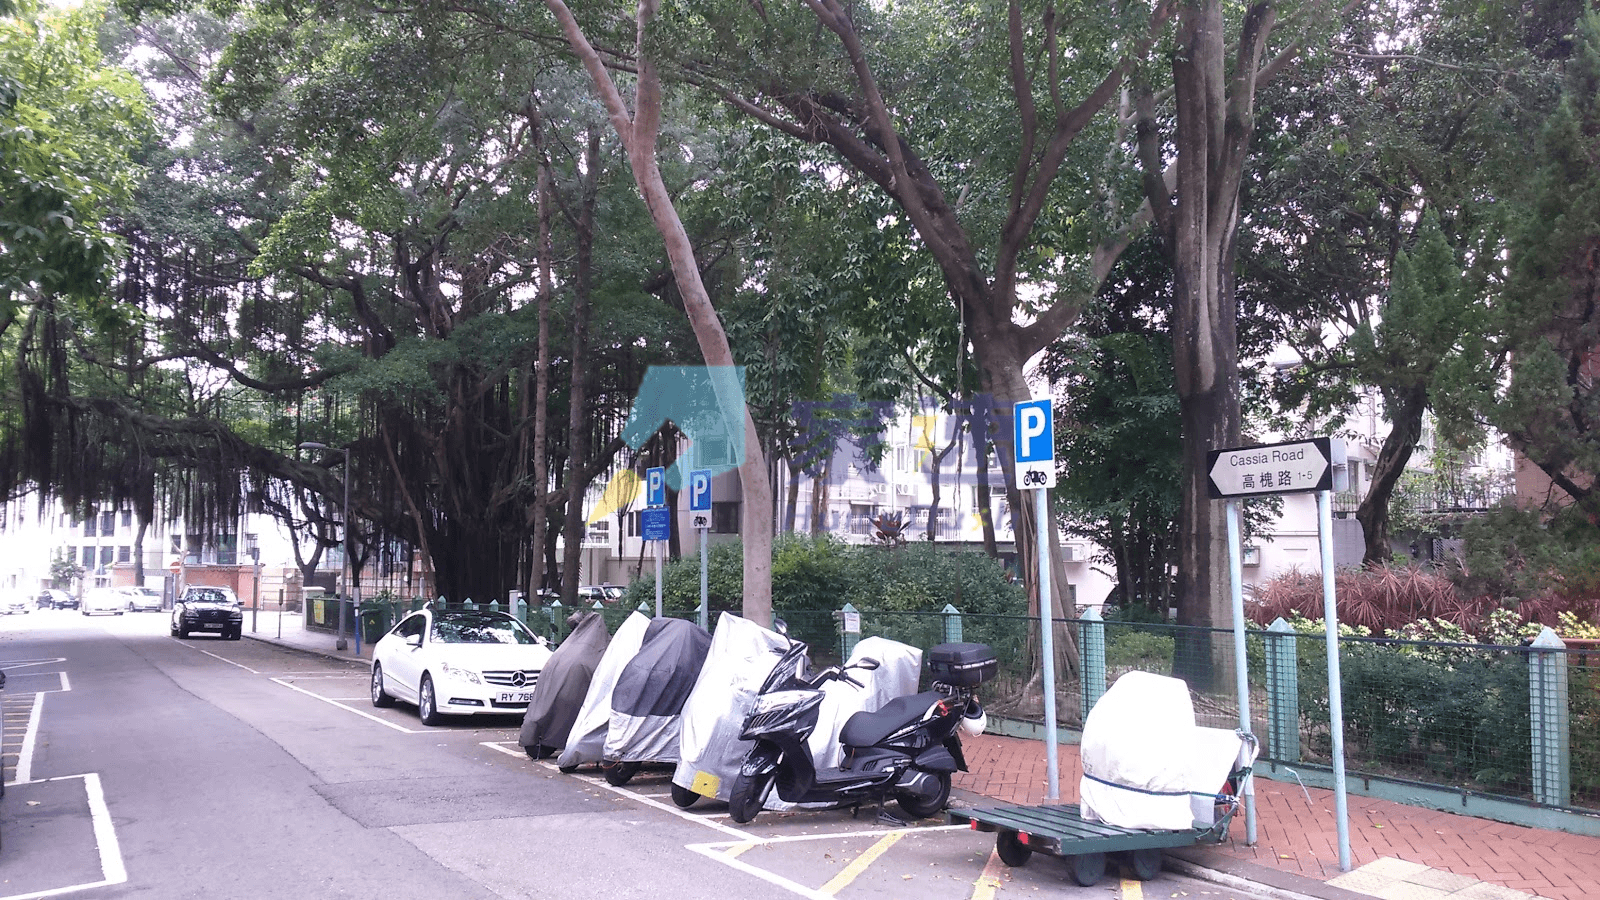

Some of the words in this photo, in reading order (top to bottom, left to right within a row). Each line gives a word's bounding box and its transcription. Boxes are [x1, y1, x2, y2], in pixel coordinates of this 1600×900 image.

[1021, 406, 1046, 457] P
[1230, 453, 1268, 467] Cassia
[1272, 448, 1304, 462] Road
[650, 471, 661, 502] P
[693, 474, 708, 507] P
[1242, 470, 1292, 490] 高槐路
[1298, 471, 1313, 481] 1-5
[501, 693, 514, 701] RY
